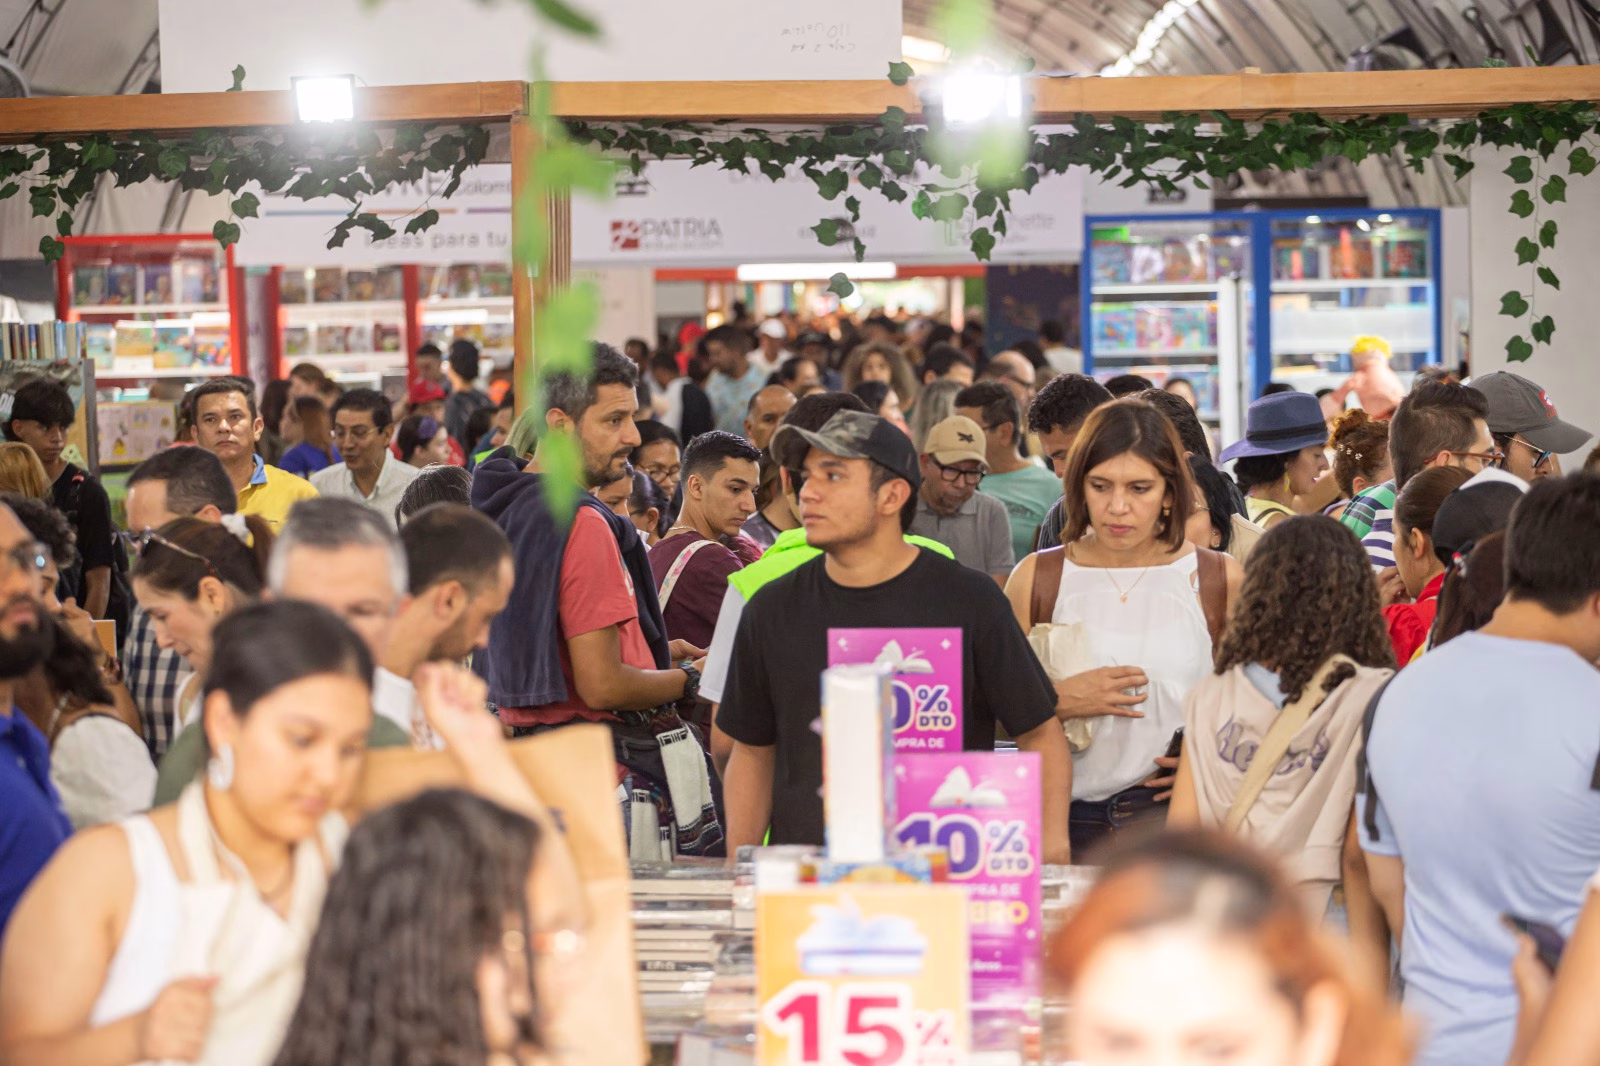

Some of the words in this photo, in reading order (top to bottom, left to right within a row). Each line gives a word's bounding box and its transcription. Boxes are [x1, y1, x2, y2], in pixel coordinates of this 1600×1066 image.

[640, 217, 723, 238] PATRIA
[430, 231, 480, 252] para
[486, 229, 508, 248] tu
[919, 715, 952, 728] DTO
[928, 738, 944, 748] DE
[990, 857, 1029, 870] DTO
[1001, 883, 1020, 896] DE
